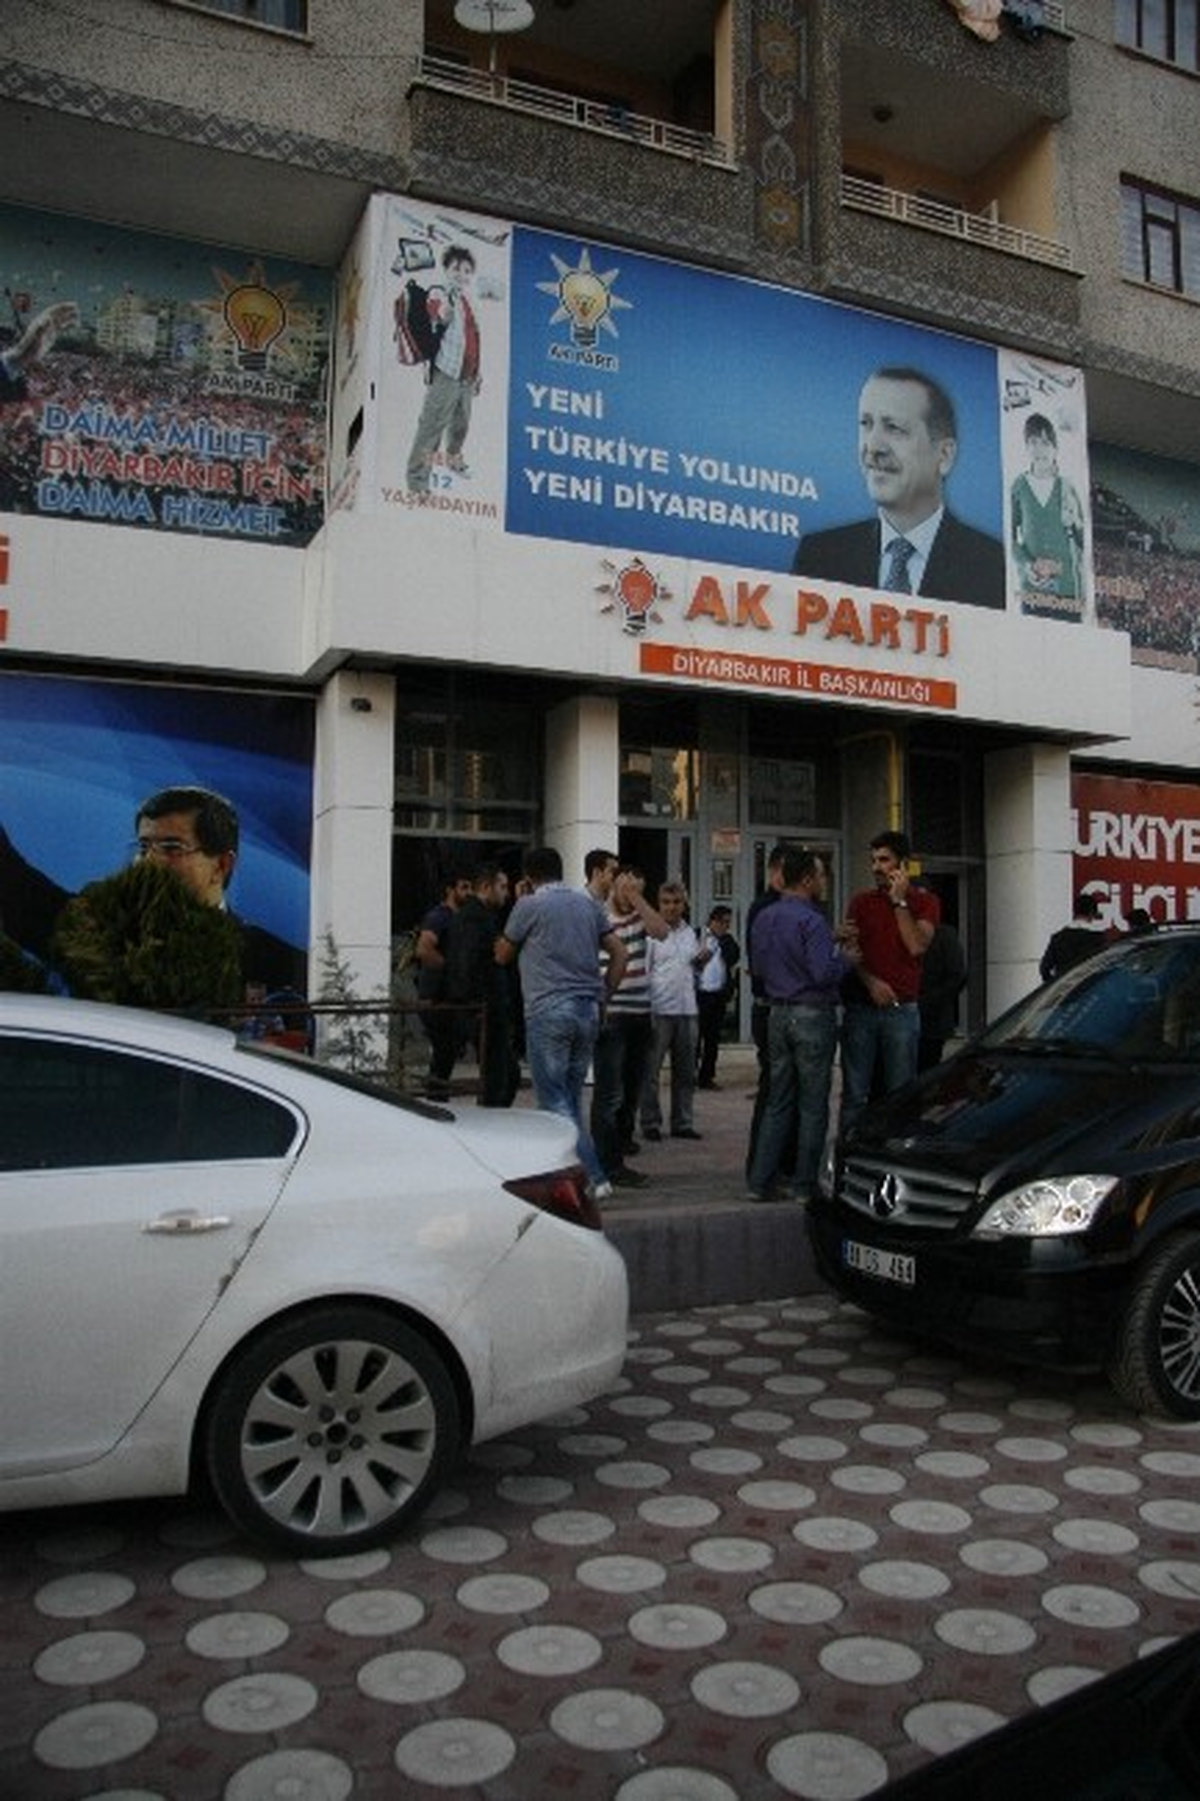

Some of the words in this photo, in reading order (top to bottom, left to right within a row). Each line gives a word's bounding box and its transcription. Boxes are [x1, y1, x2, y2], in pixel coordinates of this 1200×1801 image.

[525, 382, 604, 420] YENİ
[43, 402, 157, 444] DAİMA
[166, 417, 272, 459] MİLLET
[42, 443, 235, 494] DİYARBAKIR
[242, 457, 312, 505] İÇİN
[525, 426, 670, 475] TÜRKİYE
[679, 453, 818, 500] YOLUNDA
[39, 478, 155, 522] DAİMA
[161, 490, 285, 534] HİZMET
[524, 467, 603, 505] YENİ
[614, 482, 800, 538] DİYARBAKIR
[683, 575, 772, 630] AK
[794, 589, 950, 658] PARTİ
[673, 653, 790, 686] DİYARBAKIR
[797, 664, 812, 689] İL
[819, 672, 930, 702] BAŞKANLIĞI
[1071, 808, 1200, 864] ÜRKİYE
